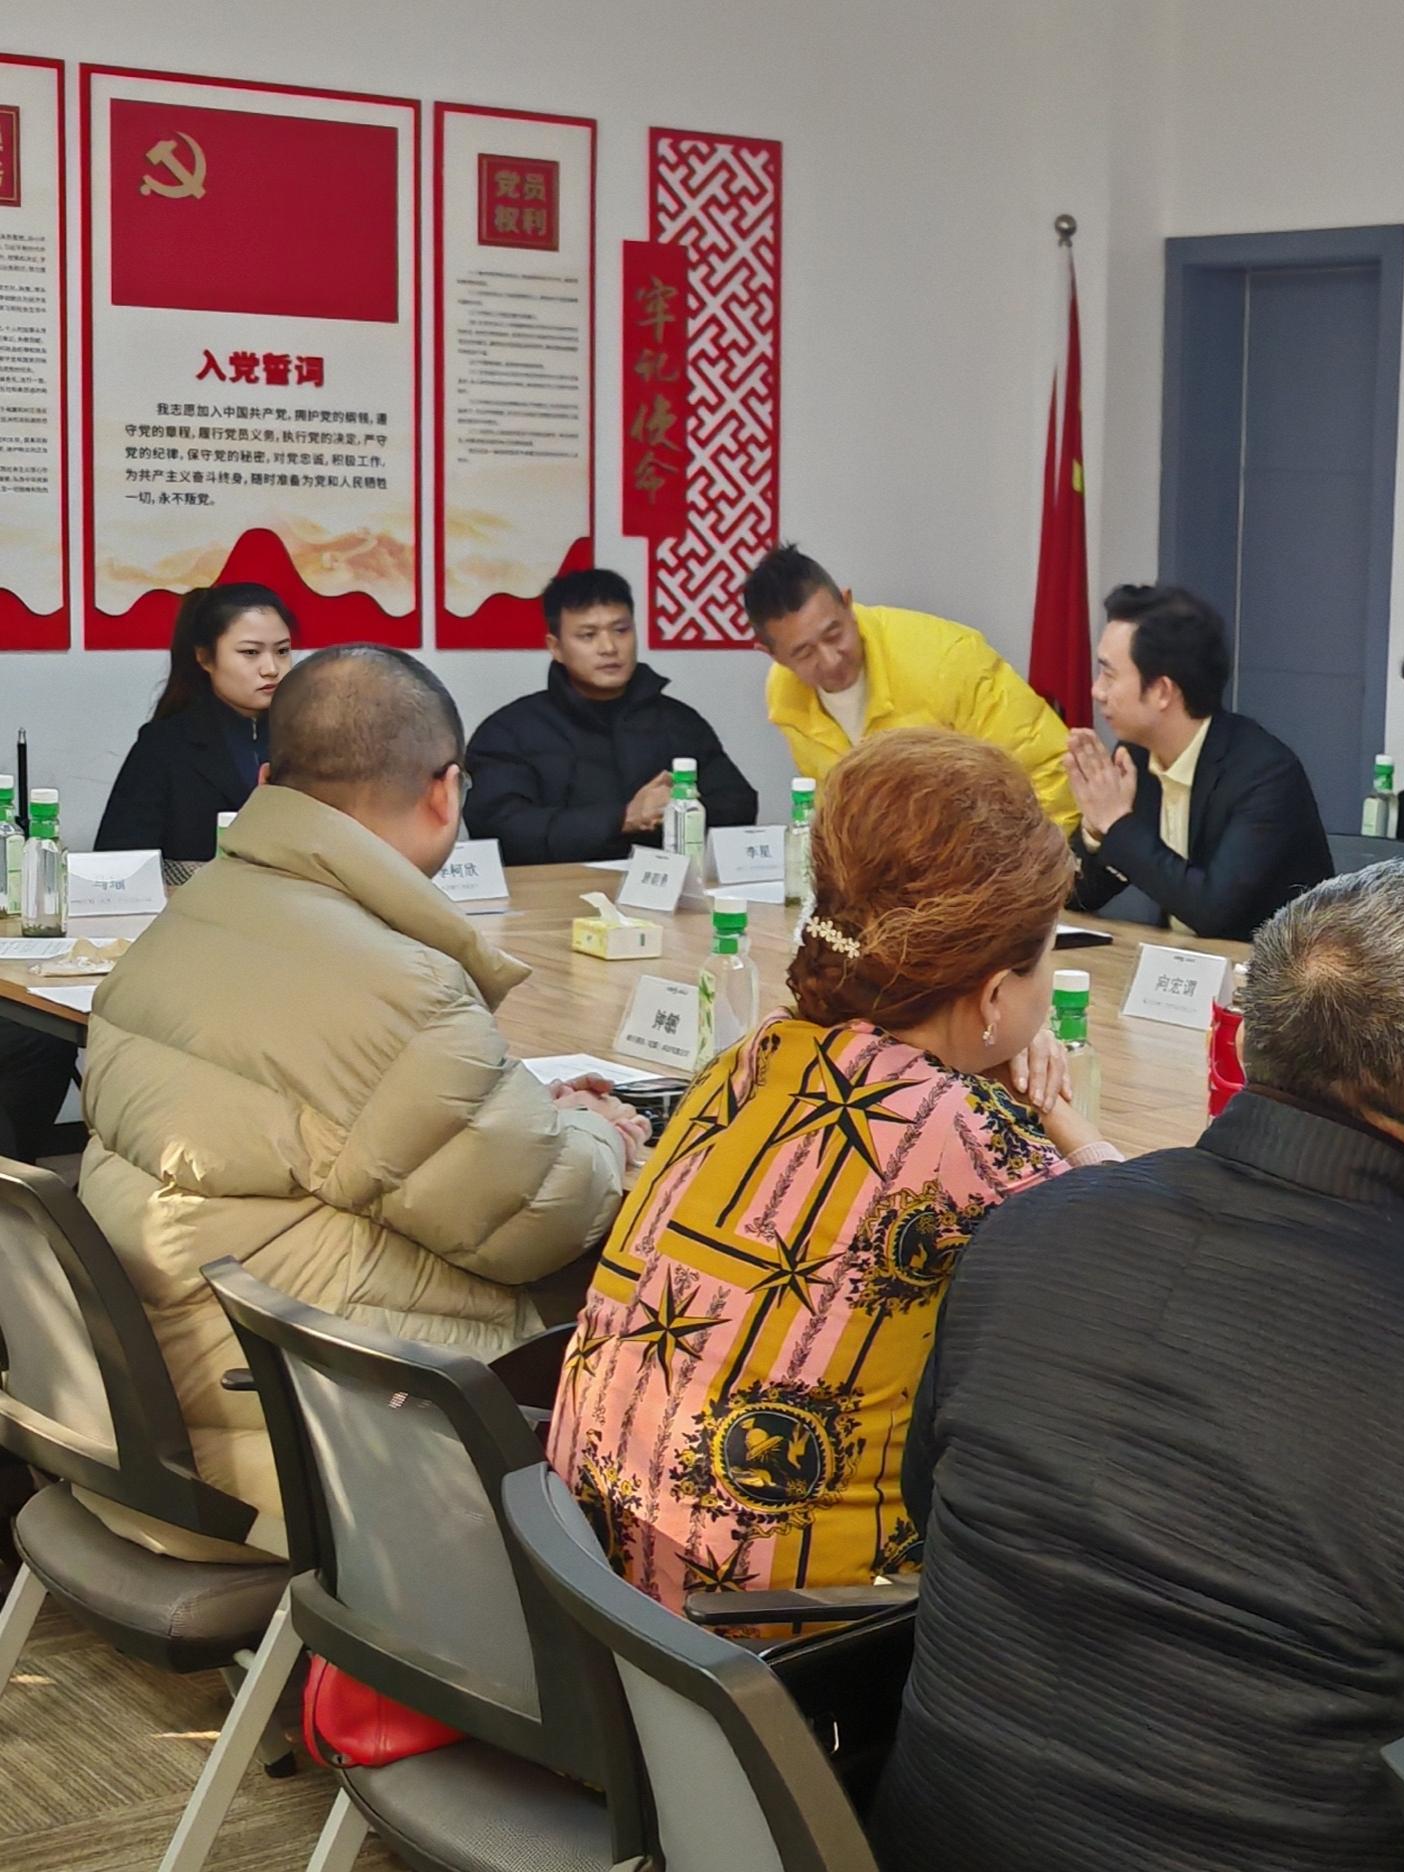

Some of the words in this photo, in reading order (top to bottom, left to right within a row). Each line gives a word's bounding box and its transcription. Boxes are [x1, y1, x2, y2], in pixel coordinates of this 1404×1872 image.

[494, 170, 547, 202] 党员
[493, 205, 548, 236] 权利
[196, 349, 324, 387] 入党誓词
[630, 275, 681, 505] 牢记使命
